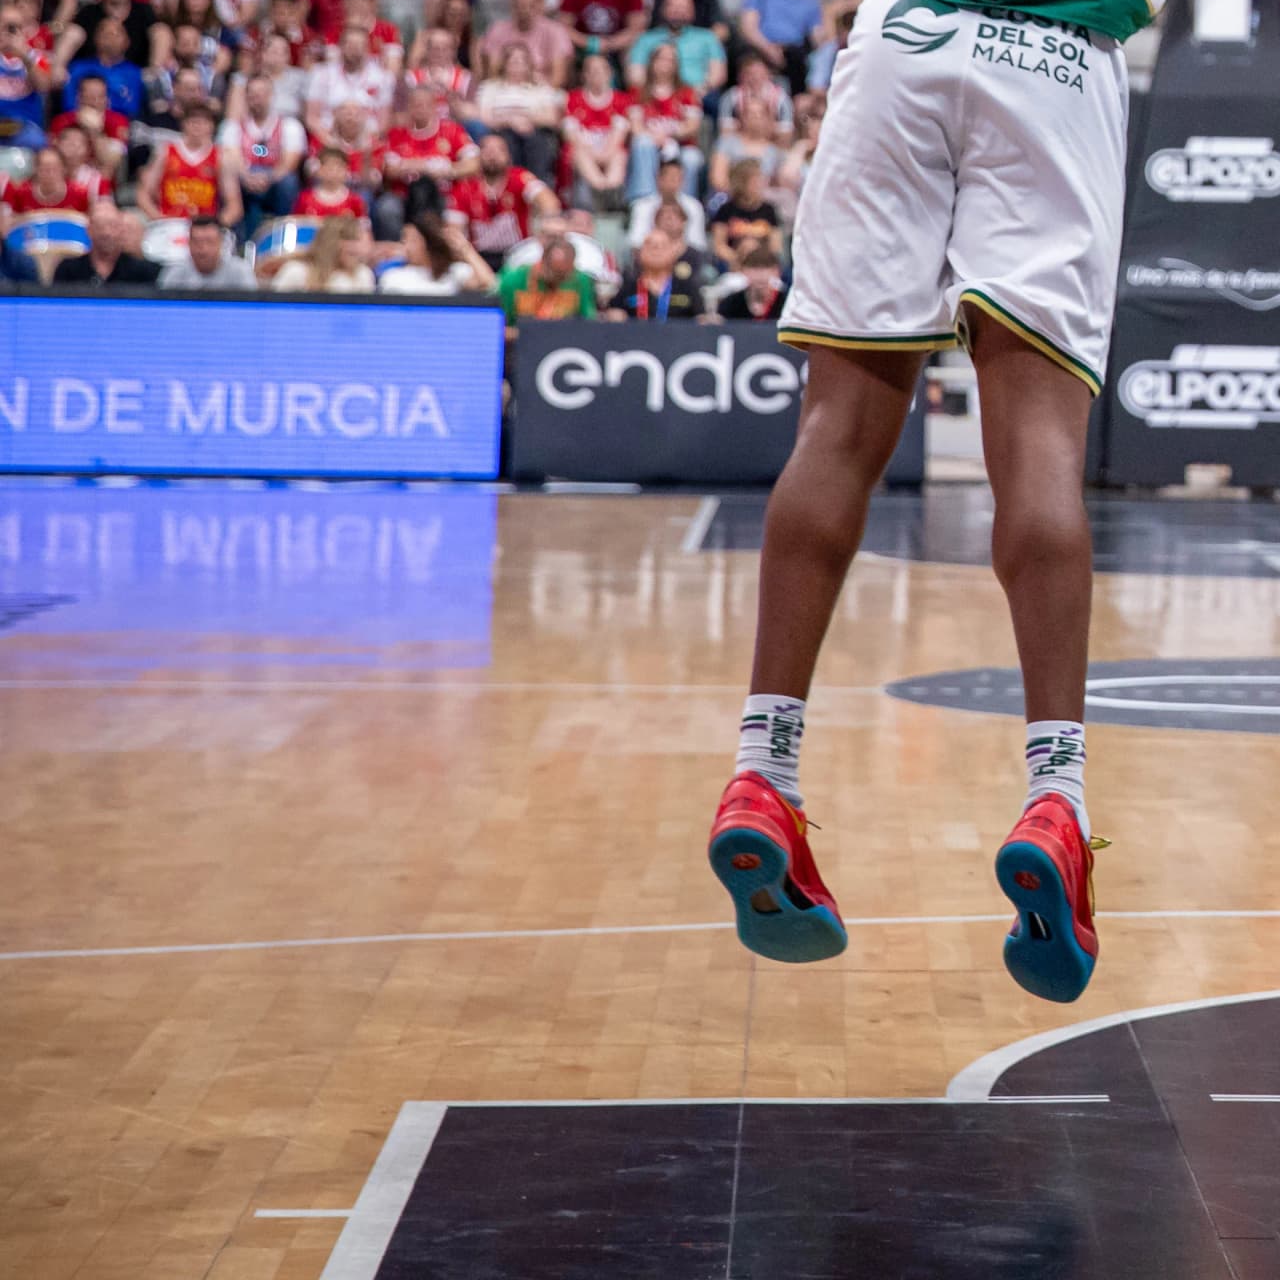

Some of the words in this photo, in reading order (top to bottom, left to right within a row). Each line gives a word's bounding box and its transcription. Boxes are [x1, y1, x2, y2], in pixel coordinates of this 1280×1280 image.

[971, 43, 1084, 94] MÁLAGA
[977, 23, 1033, 48] DEL
[1040, 35, 1089, 71] SOL
[535, 334, 808, 417] ende
[52, 378, 144, 434] DE
[168, 379, 449, 439] MURCIA
